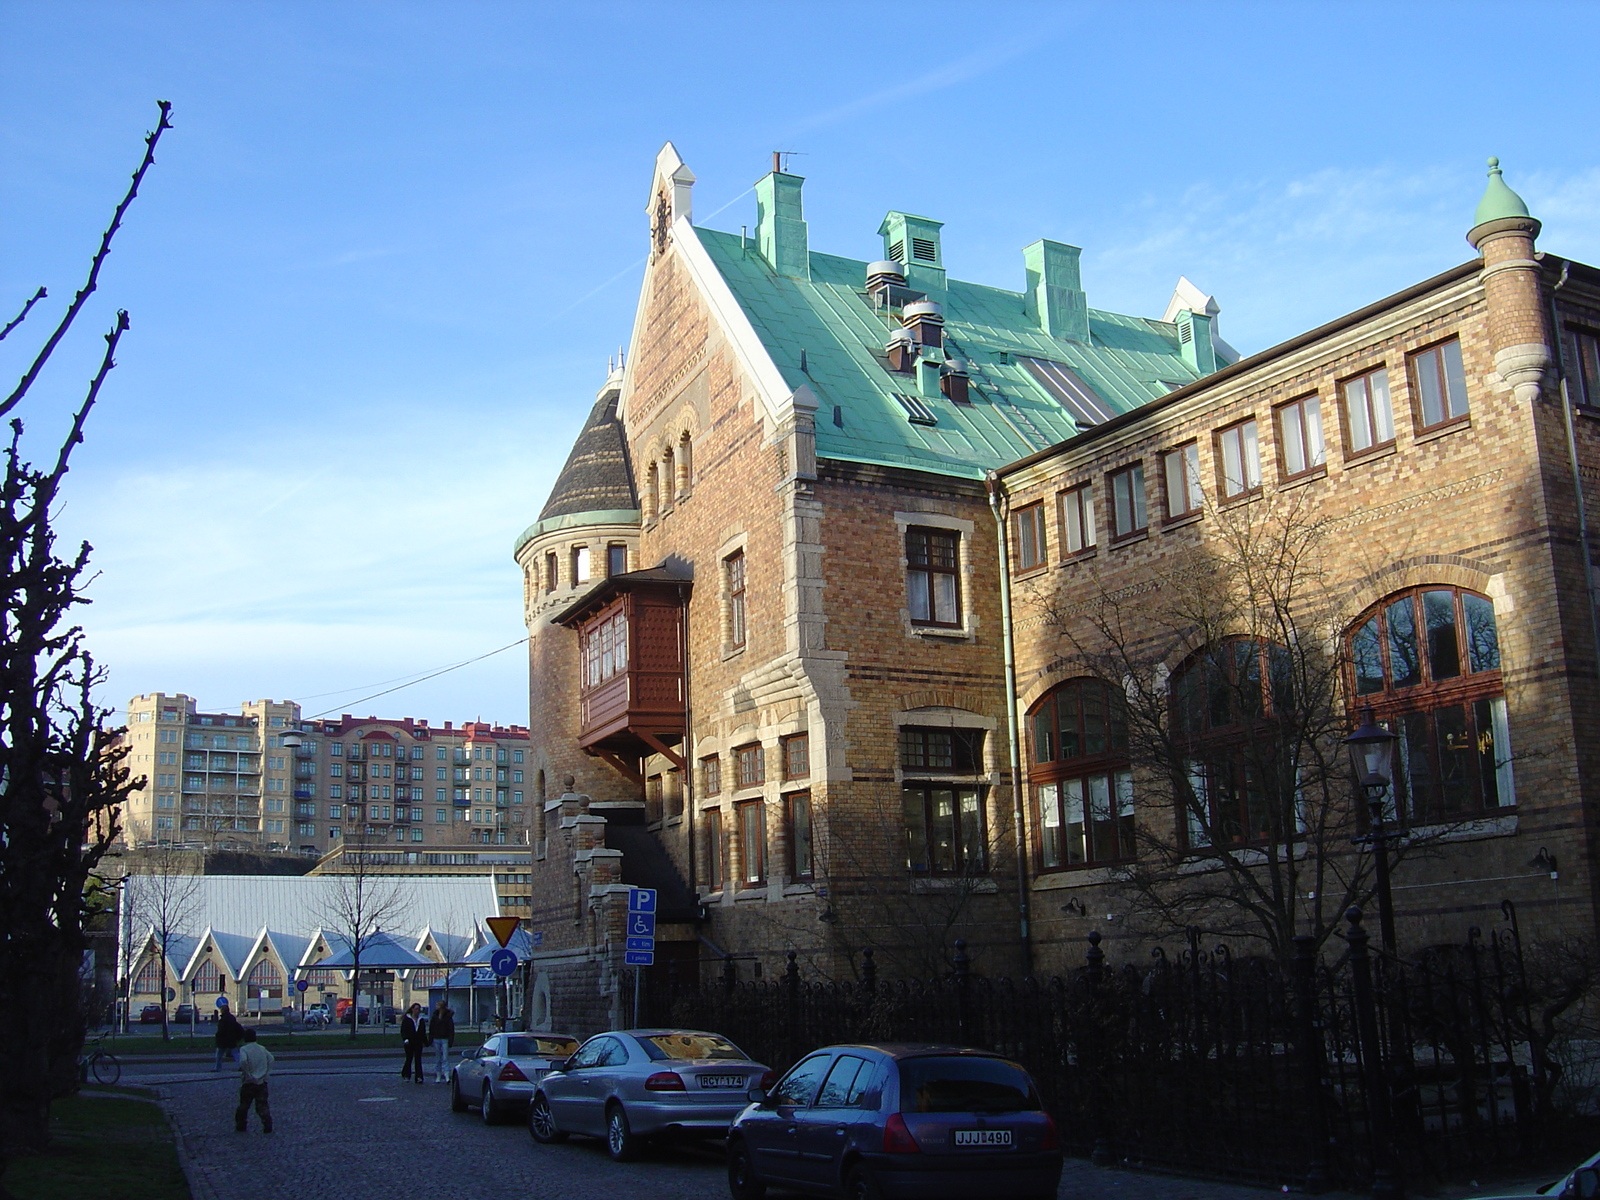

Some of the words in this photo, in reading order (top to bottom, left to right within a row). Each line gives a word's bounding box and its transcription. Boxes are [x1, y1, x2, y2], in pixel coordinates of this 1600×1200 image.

[637, 891, 650, 909] P
[703, 1076, 719, 1085] RCY
[725, 1076, 742, 1085] 174
[957, 1132, 980, 1144] JJJ
[987, 1132, 1010, 1144] 490
